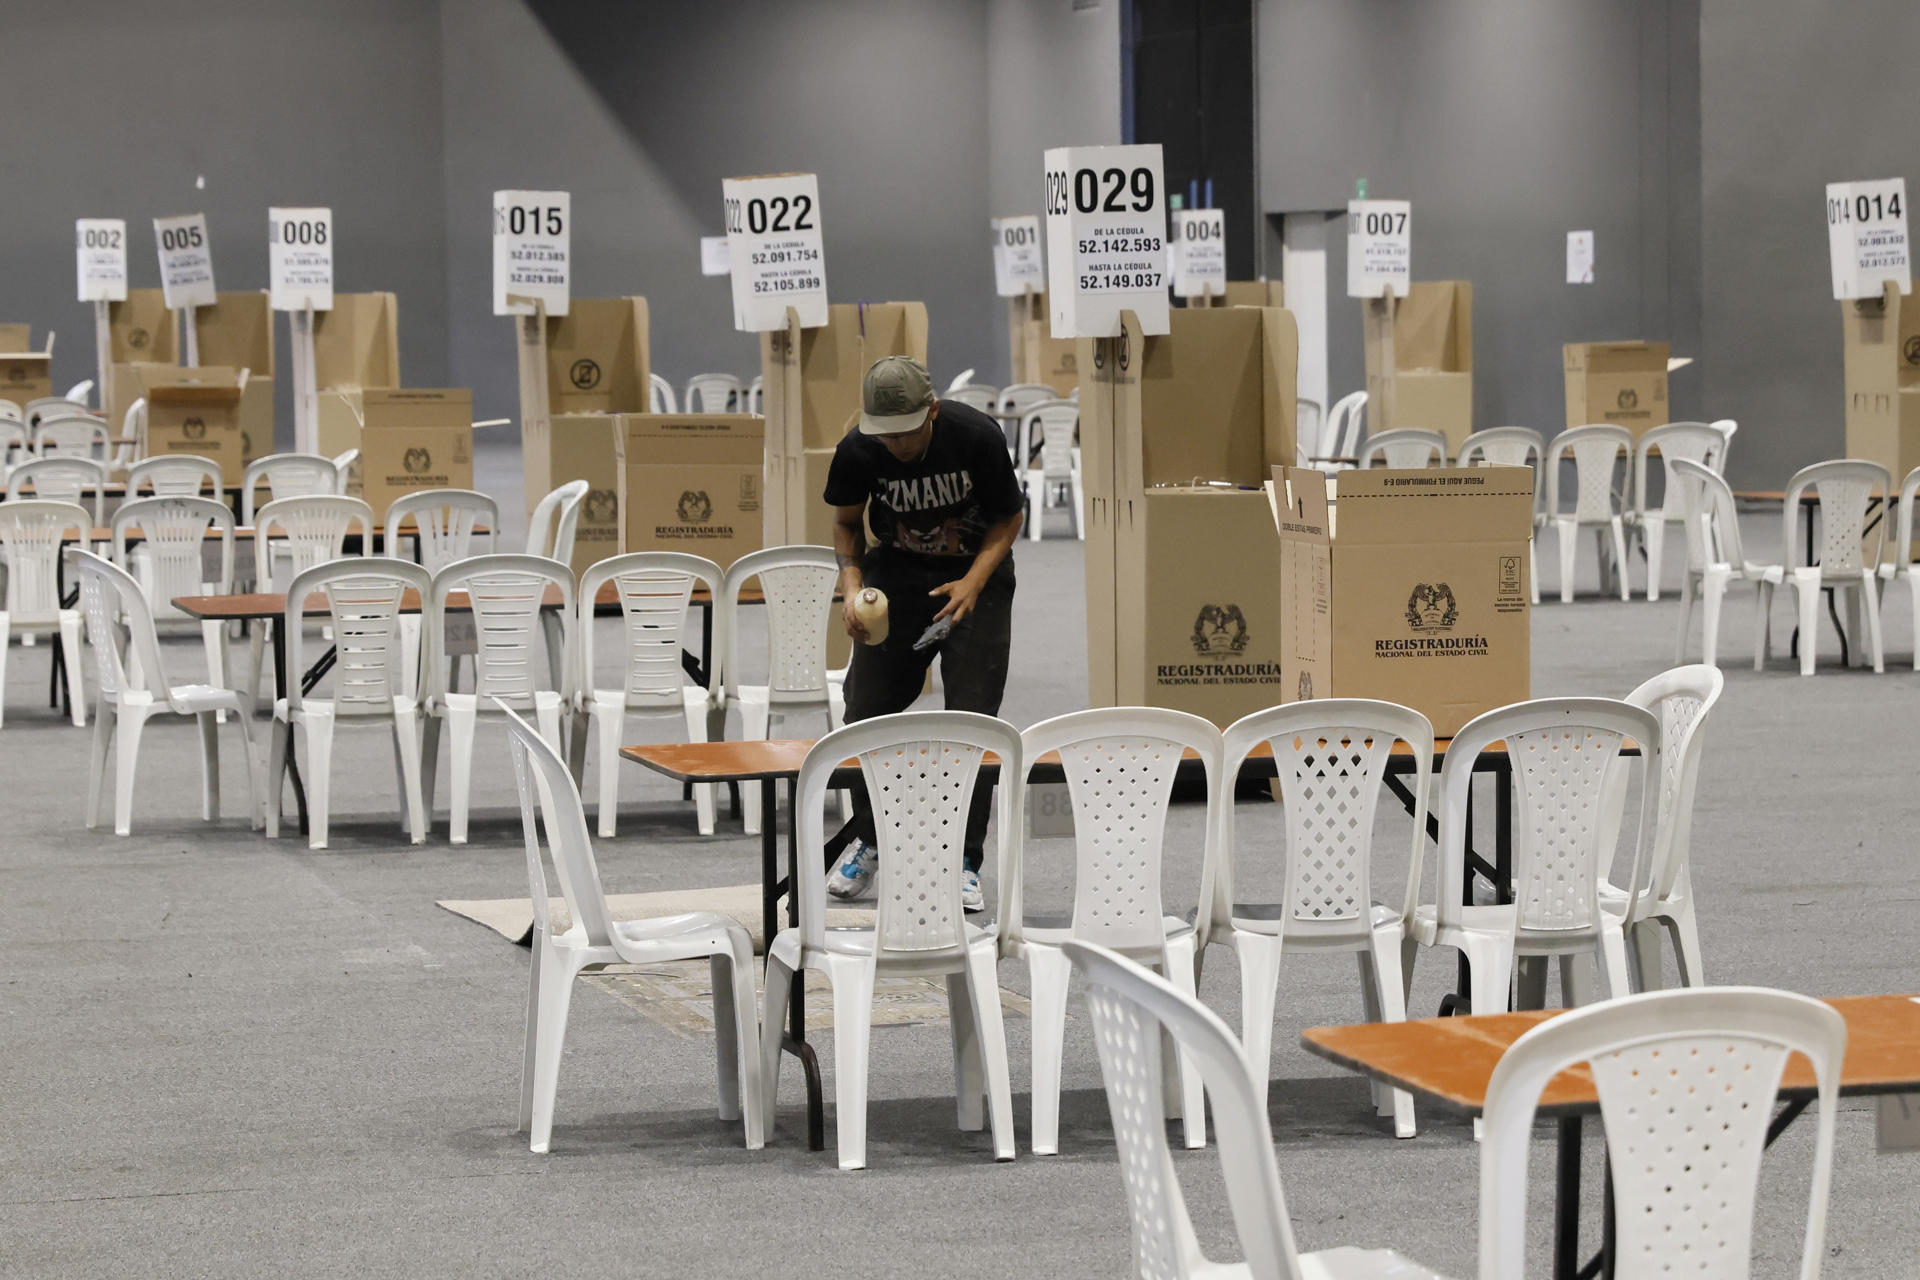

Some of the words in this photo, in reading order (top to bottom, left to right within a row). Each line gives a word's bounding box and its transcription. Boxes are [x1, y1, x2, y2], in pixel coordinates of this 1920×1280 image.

[1046, 171, 1068, 216] 029
[1074, 167, 1154, 214] 029
[747, 194, 813, 235] 022
[1828, 197, 1850, 225] 014
[1856, 192, 1902, 222] 014
[510, 206, 563, 235] 015
[1367, 213, 1407, 235] 007
[86, 229, 121, 249] 002
[162, 226, 202, 250] 005
[284, 221, 327, 245] 008
[1005, 227, 1035, 246] 001
[1094, 228, 1103, 236] DE
[1186, 220, 1221, 242] 004
[1079, 238, 1161, 254] 52.142.593
[752, 250, 818, 264] 52.091.754
[754, 277, 820, 292] 52.105.899
[1080, 273, 1162, 289] 52.149.037
[1464, 477, 1484, 485] PEGUE
[1375, 633, 1488, 651] REGISTRADURÍA
[1435, 649, 1466, 657] ESTADO
[1157, 660, 1281, 677] REGISTRADURÍA
[1157, 677, 1199, 685] NACIONAL
[1203, 677, 1219, 685] DEL
[1223, 677, 1257, 685] ESTADO
